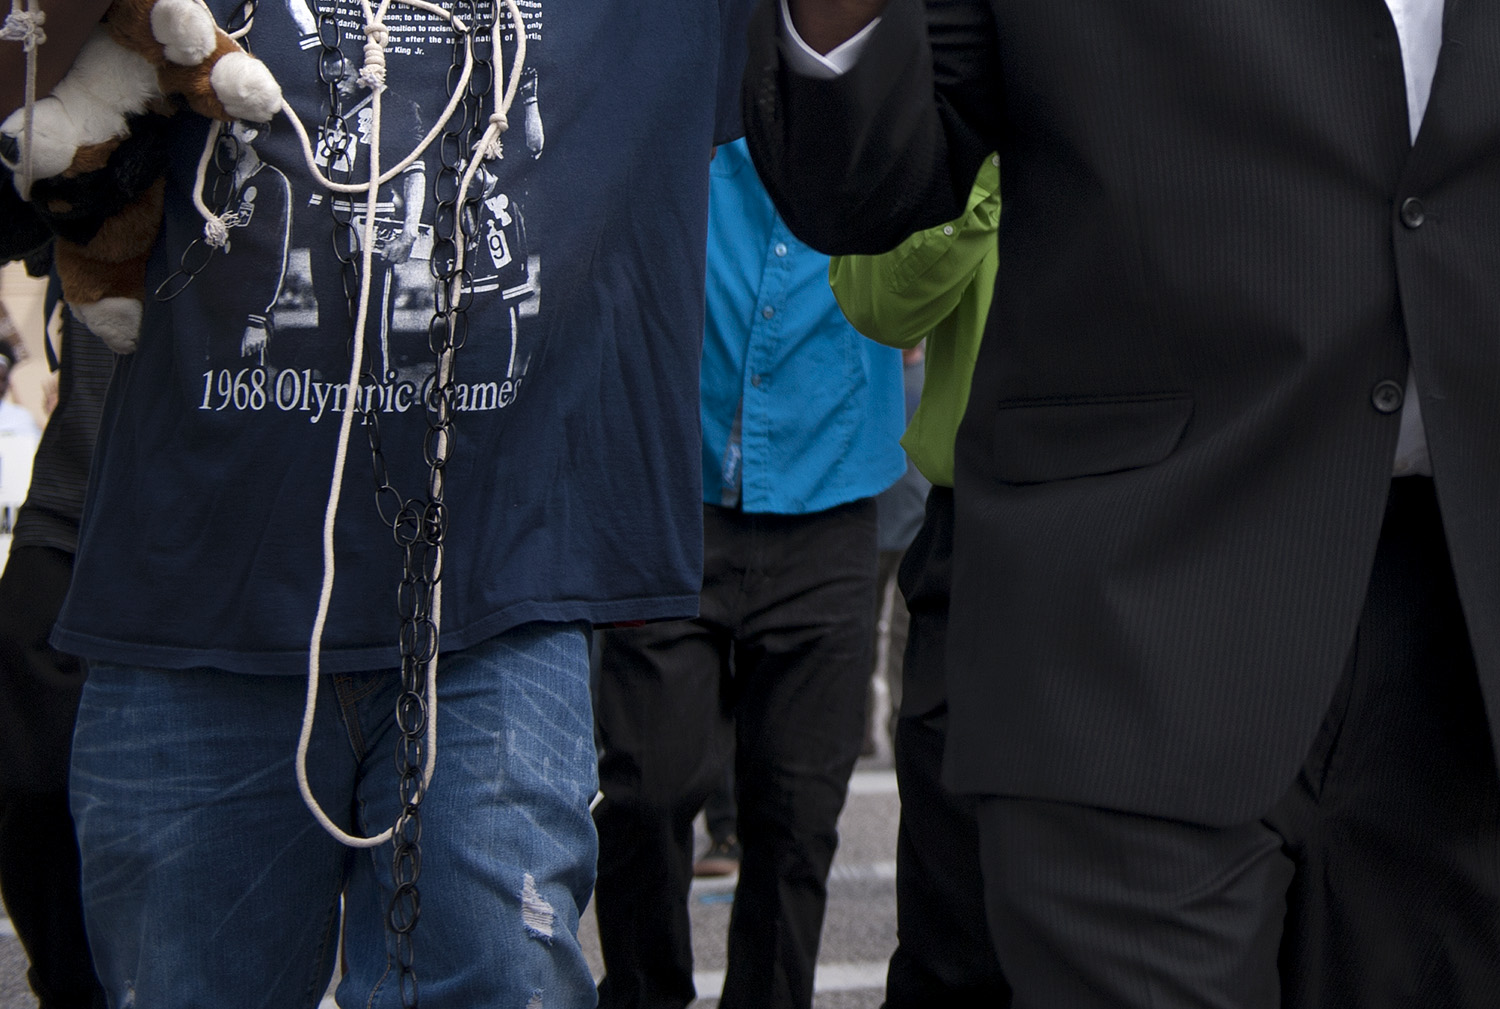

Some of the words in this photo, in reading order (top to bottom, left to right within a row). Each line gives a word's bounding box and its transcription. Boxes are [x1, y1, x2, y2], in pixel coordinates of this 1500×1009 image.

[527, 22, 542, 30] only
[405, 35, 425, 43] after
[429, 36, 441, 44] the
[395, 46, 411, 55] King
[198, 368, 267, 411] 1968
